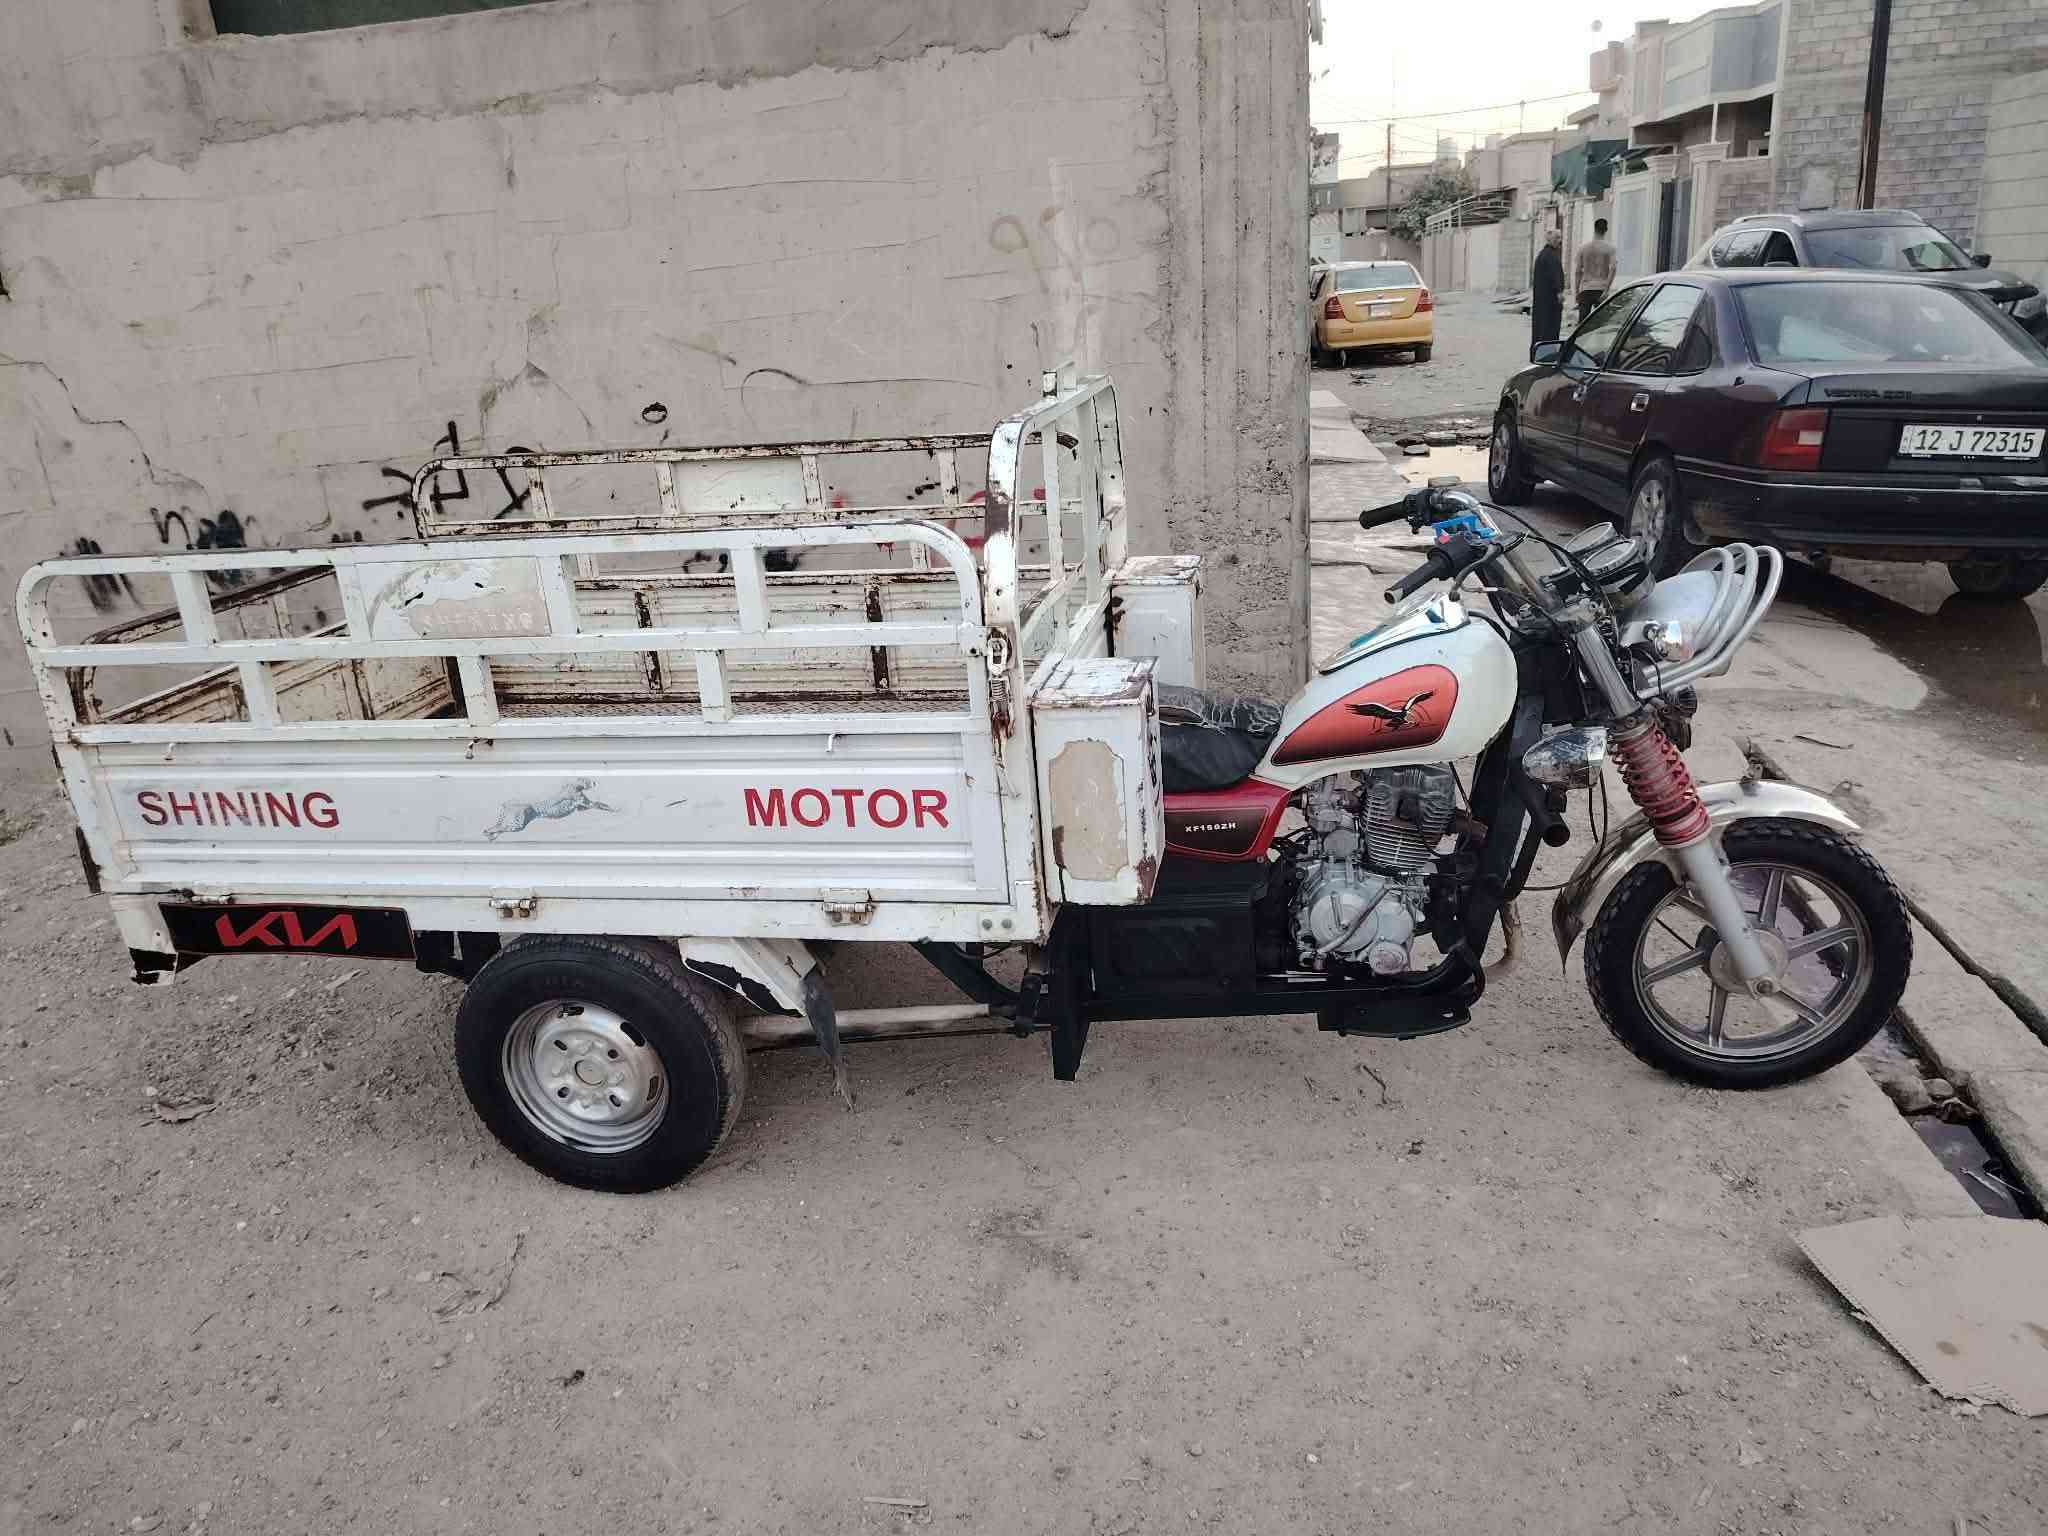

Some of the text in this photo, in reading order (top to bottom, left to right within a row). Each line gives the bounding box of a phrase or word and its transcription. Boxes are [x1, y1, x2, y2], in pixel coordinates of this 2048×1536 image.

[1914, 429, 2036, 453] 12 J 72315
[136, 788, 949, 829] SHINING MOTOR
